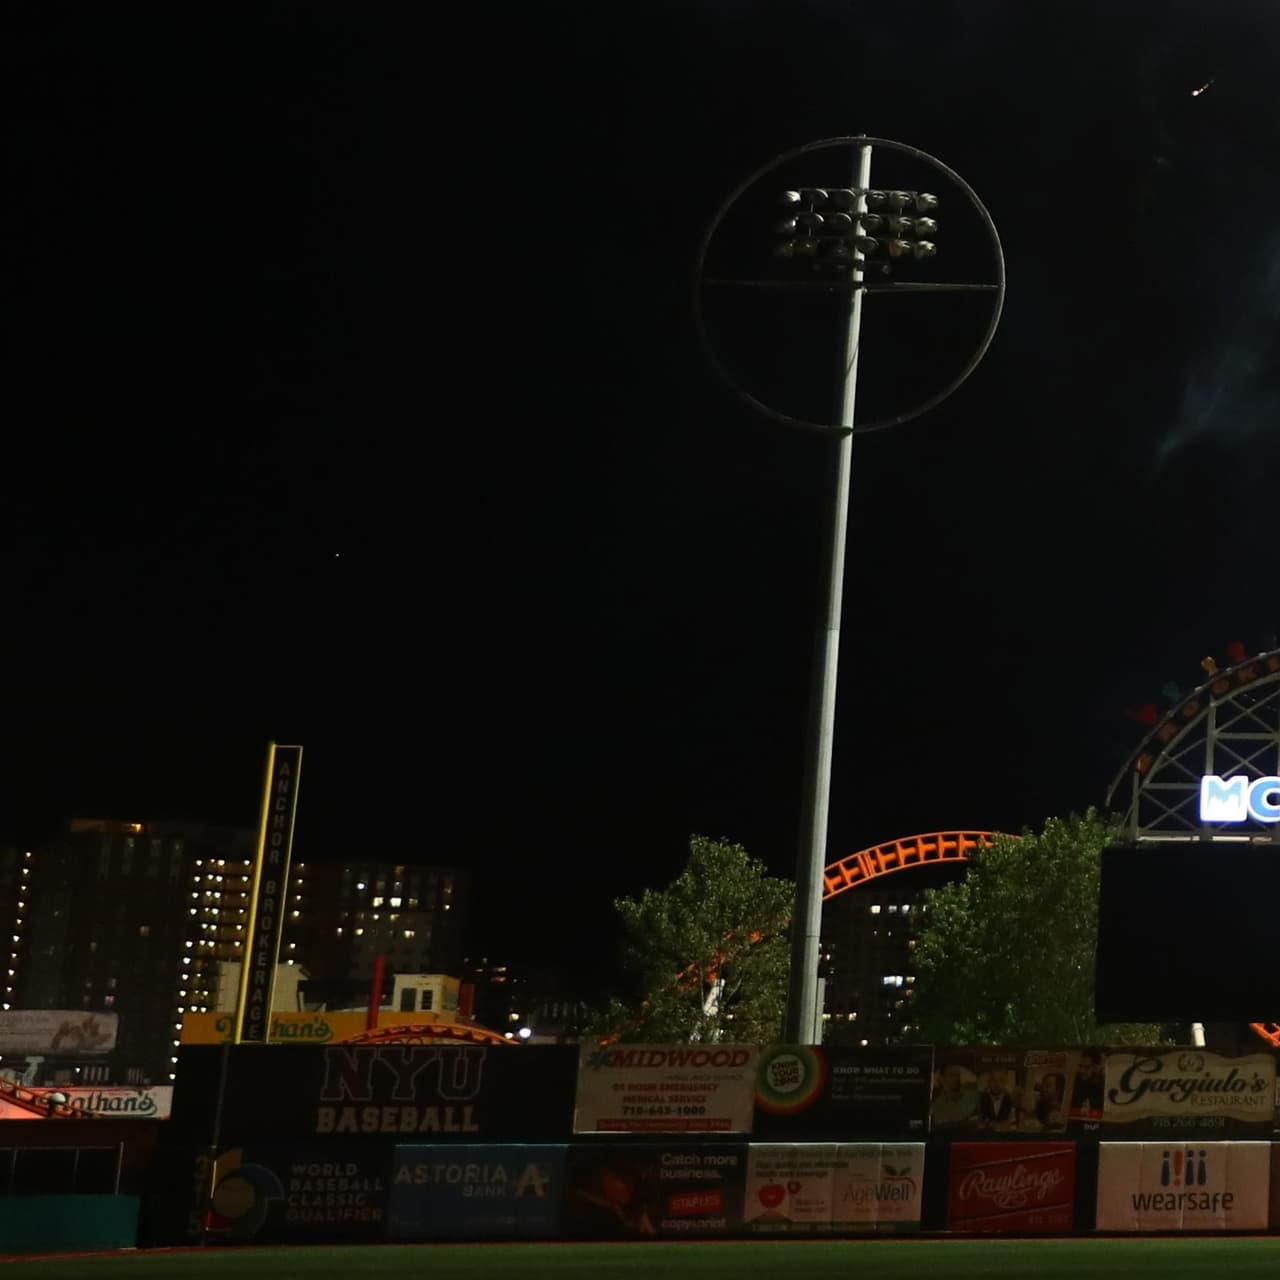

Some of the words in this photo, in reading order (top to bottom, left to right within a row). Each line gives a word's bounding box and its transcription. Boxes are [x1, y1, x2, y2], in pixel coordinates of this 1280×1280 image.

[269, 761, 291, 864] ANCHOR
[249, 880, 276, 1040] BROKERAGE
[611, 1049, 750, 1068] MIDWOOD
[319, 1047, 488, 1102] NYU
[773, 1068, 799, 1079] YOUR
[863, 1066, 889, 1075] WHAT
[1108, 1055, 1268, 1104] Gargiulo's
[1190, 1095, 1267, 1105] RESTAURANT
[315, 1104, 480, 1134] BASEBALL
[660, 1152, 700, 1166] Catch
[703, 1154, 739, 1166] more
[291, 1163, 358, 1177] WORLD
[394, 1163, 509, 1185] ASTORIA
[289, 1177, 385, 1192] BASEBALL
[462, 1184, 508, 1199] BANK
[958, 1163, 1066, 1204] Rawlings
[287, 1193, 368, 1207] CLASSIC
[842, 1183, 911, 1206] AgeWell
[1131, 1191, 1234, 1212] wearsafe
[285, 1208, 385, 1222] QUALIFIER
